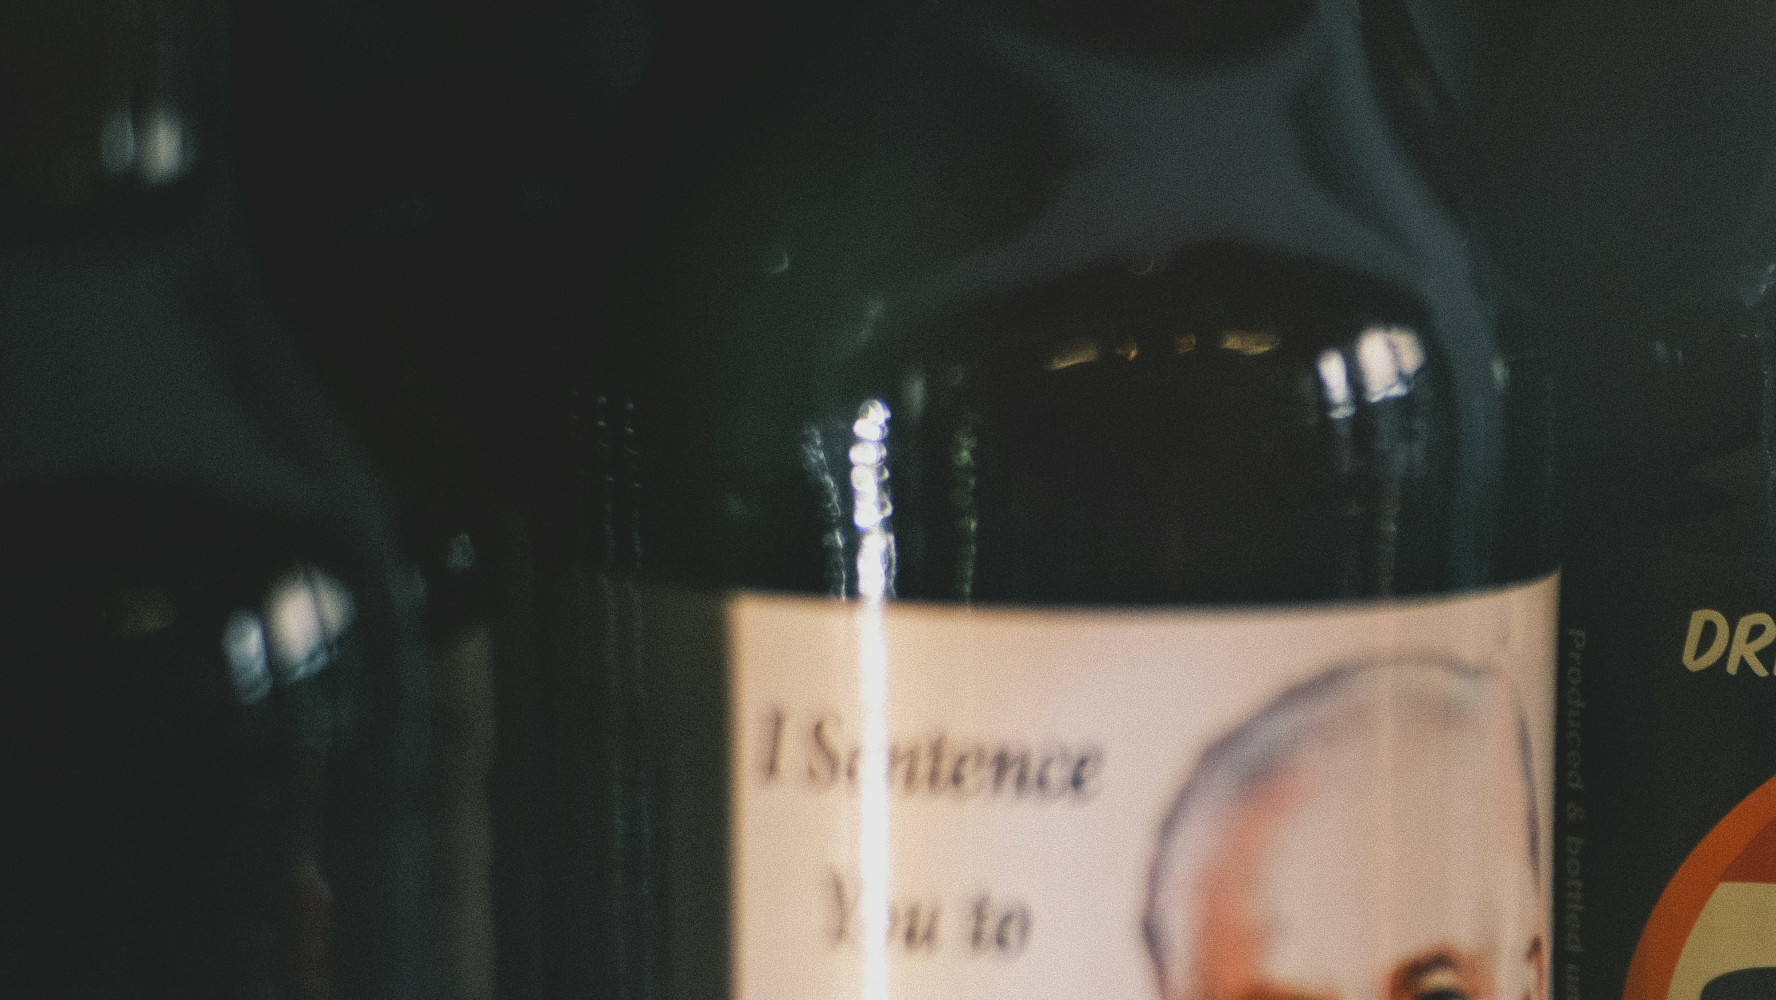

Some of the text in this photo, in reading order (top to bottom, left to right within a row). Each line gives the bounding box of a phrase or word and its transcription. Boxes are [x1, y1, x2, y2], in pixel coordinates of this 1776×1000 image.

[758, 703, 788, 786] I
[1565, 628, 1586, 791] Produced
[1565, 800, 1585, 822] &
[825, 866, 1033, 956] Yu to
[1564, 835, 1585, 953] bottled
